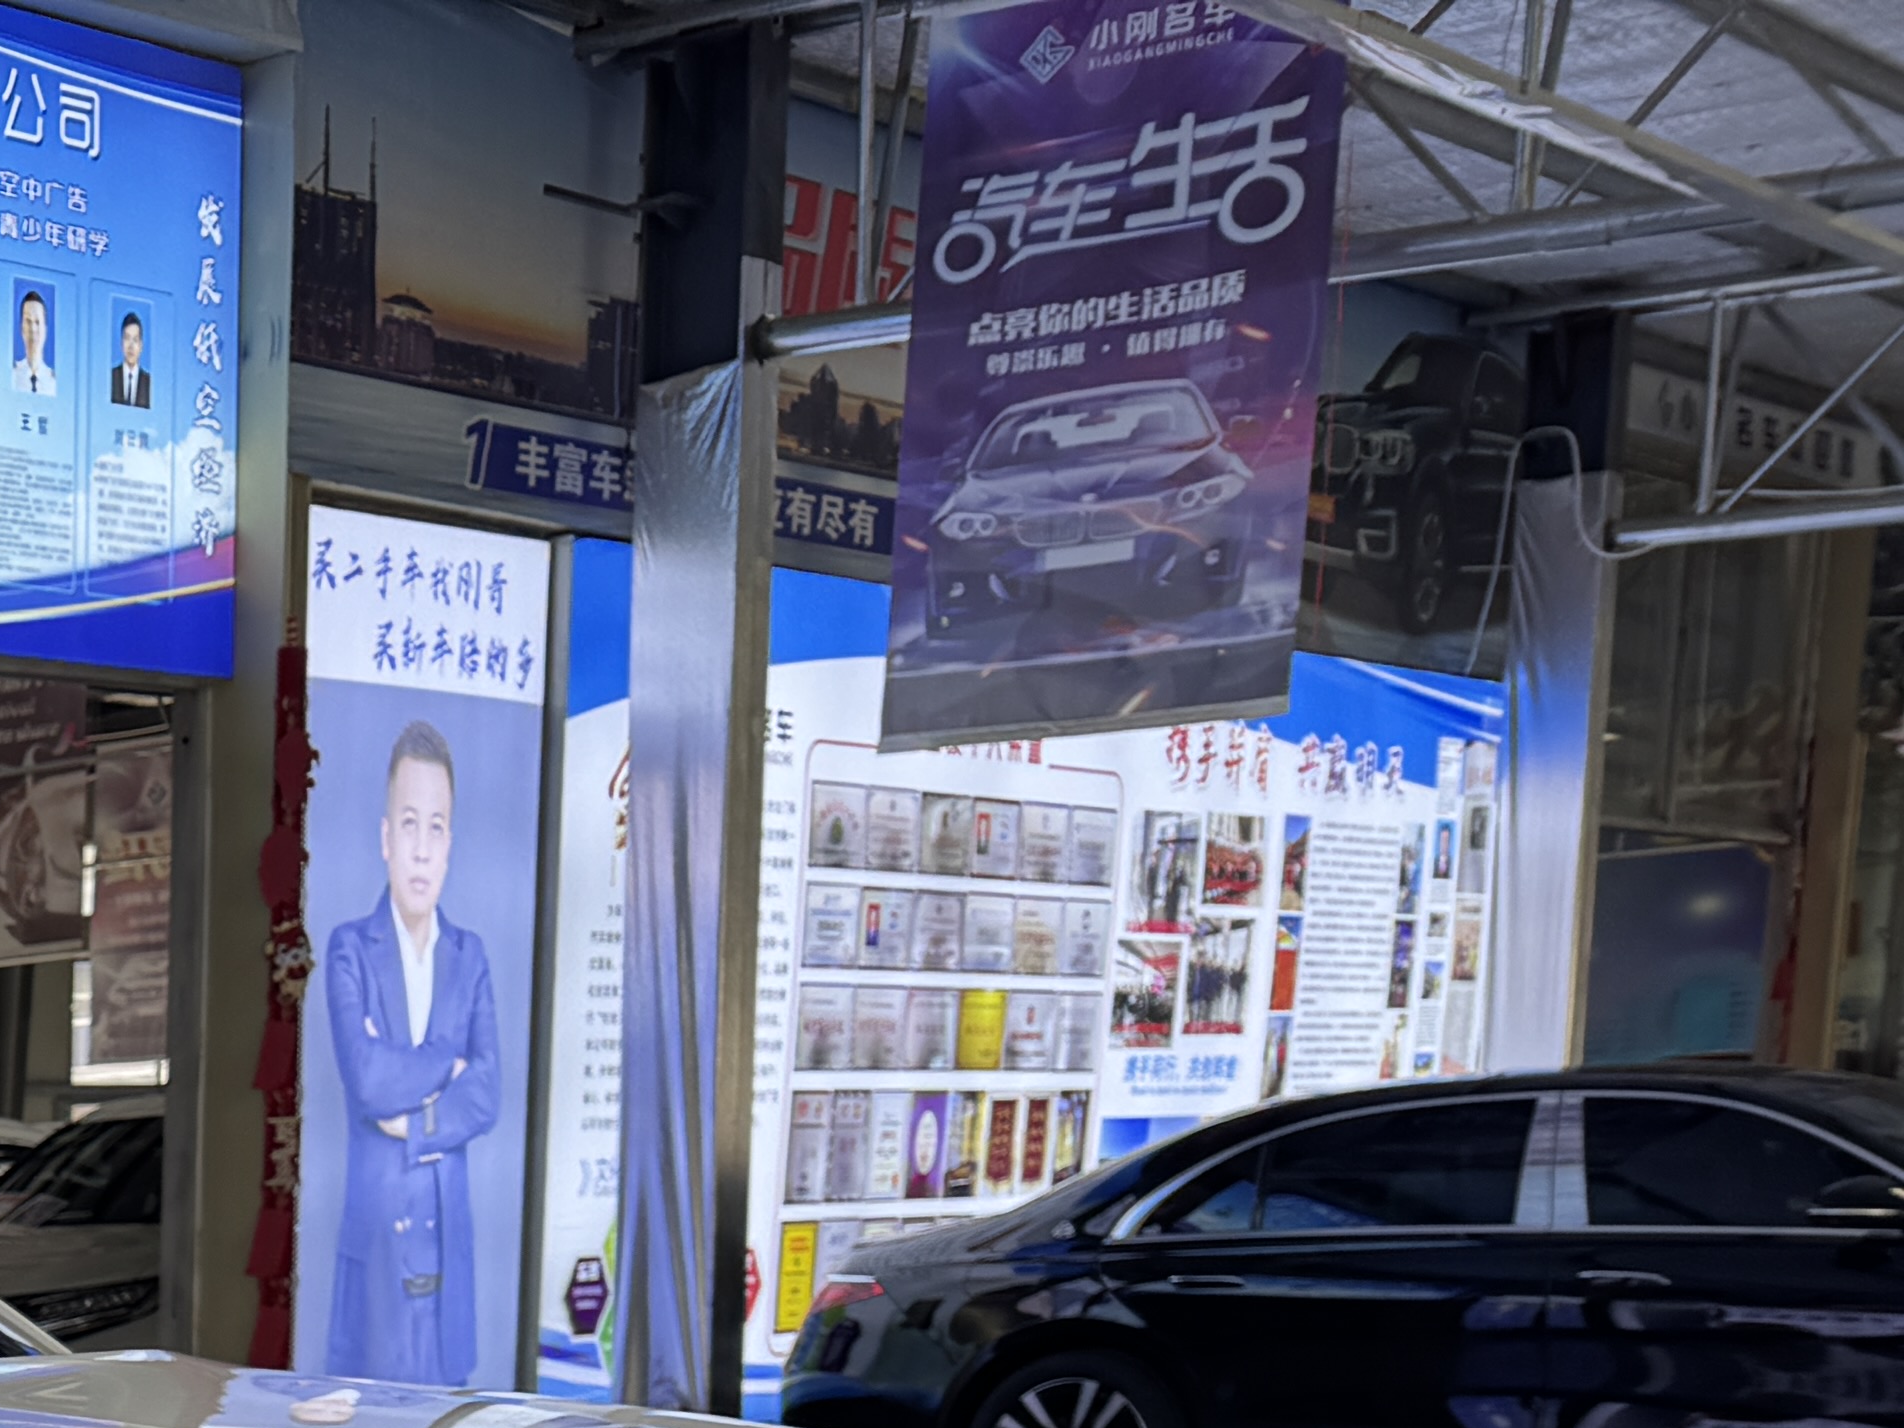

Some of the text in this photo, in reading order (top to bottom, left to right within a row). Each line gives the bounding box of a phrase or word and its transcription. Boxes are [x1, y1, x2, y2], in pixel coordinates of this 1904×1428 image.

[933, 95, 1310, 284] 汽车生活
[0, 209, 110, 257] 青少年研学
[773, 484, 879, 547] 有尽有
